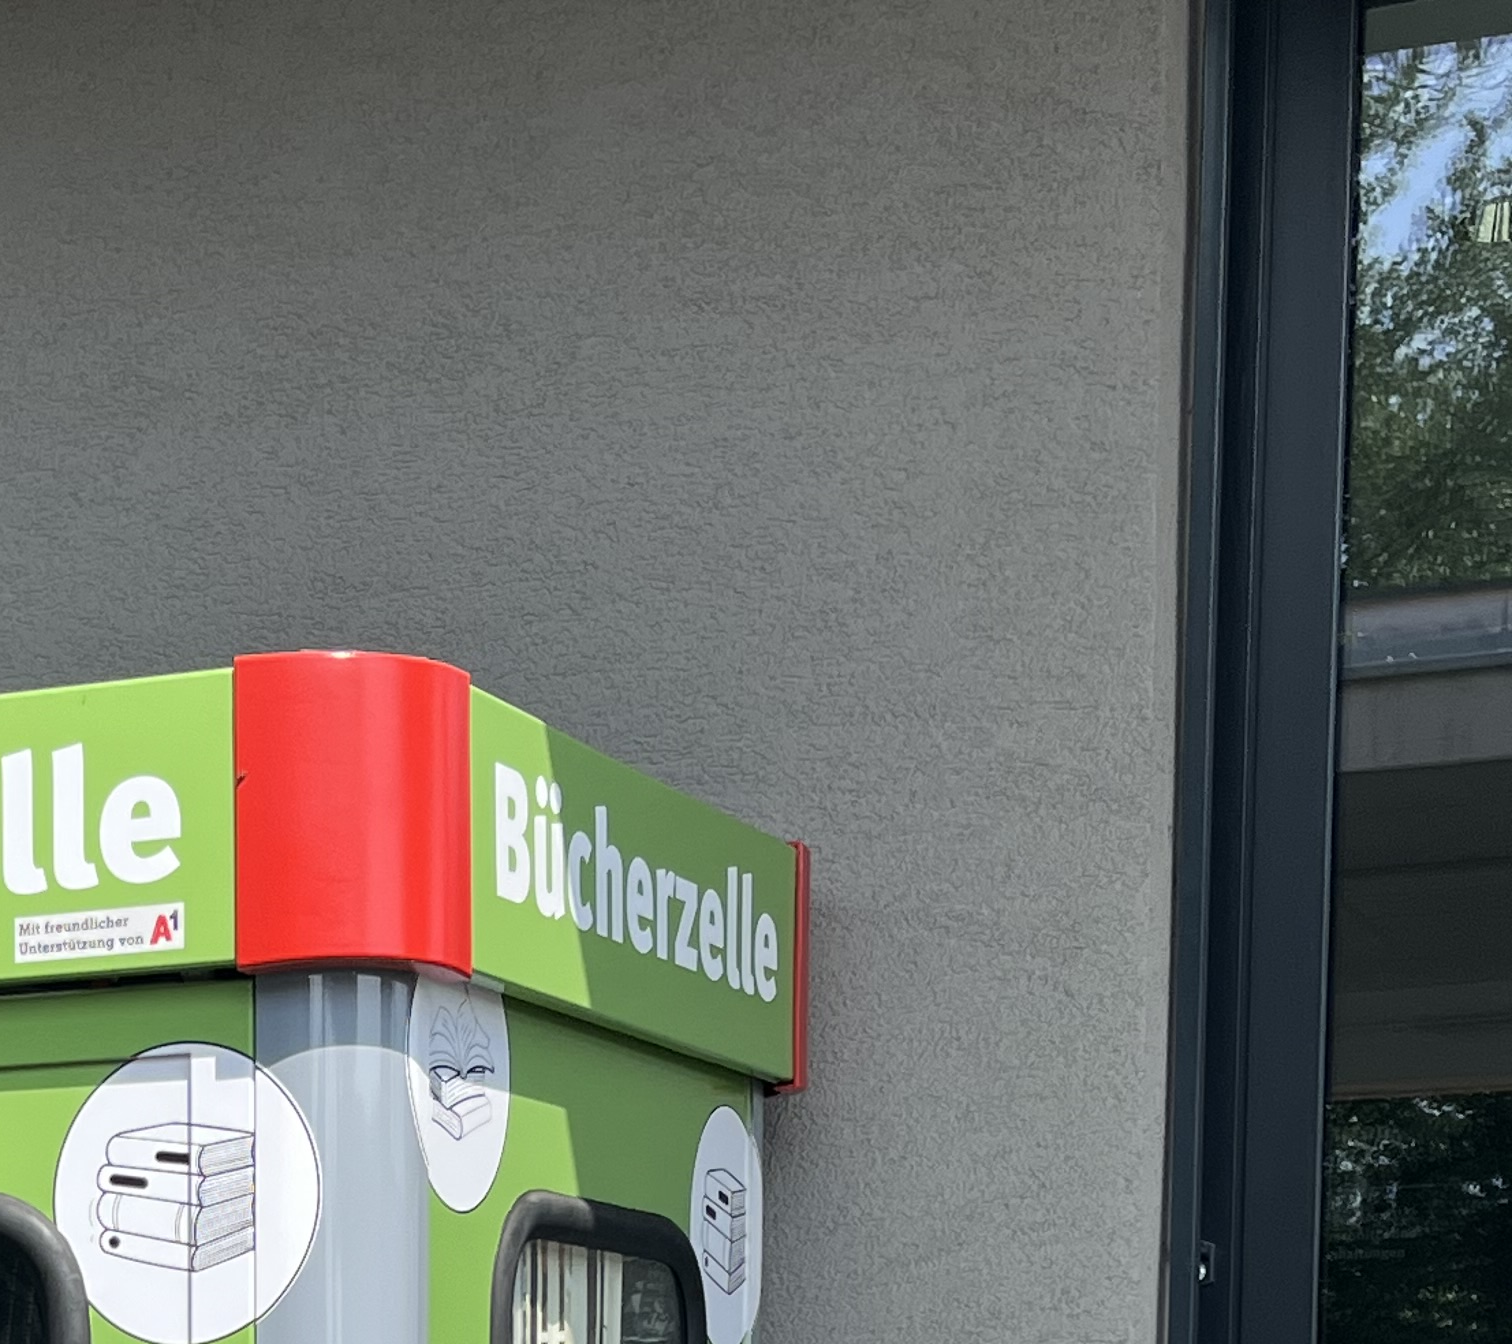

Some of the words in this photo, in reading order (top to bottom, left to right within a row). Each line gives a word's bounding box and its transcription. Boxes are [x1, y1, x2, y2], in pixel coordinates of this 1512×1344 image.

[494, 761, 778, 1002] Bücherzelle
[18, 922, 40, 937] Mit
[44, 916, 129, 934] freundlicher
[149, 909, 179, 945] A1
[18, 936, 115, 955] Unterstützung
[119, 935, 144, 946] von
